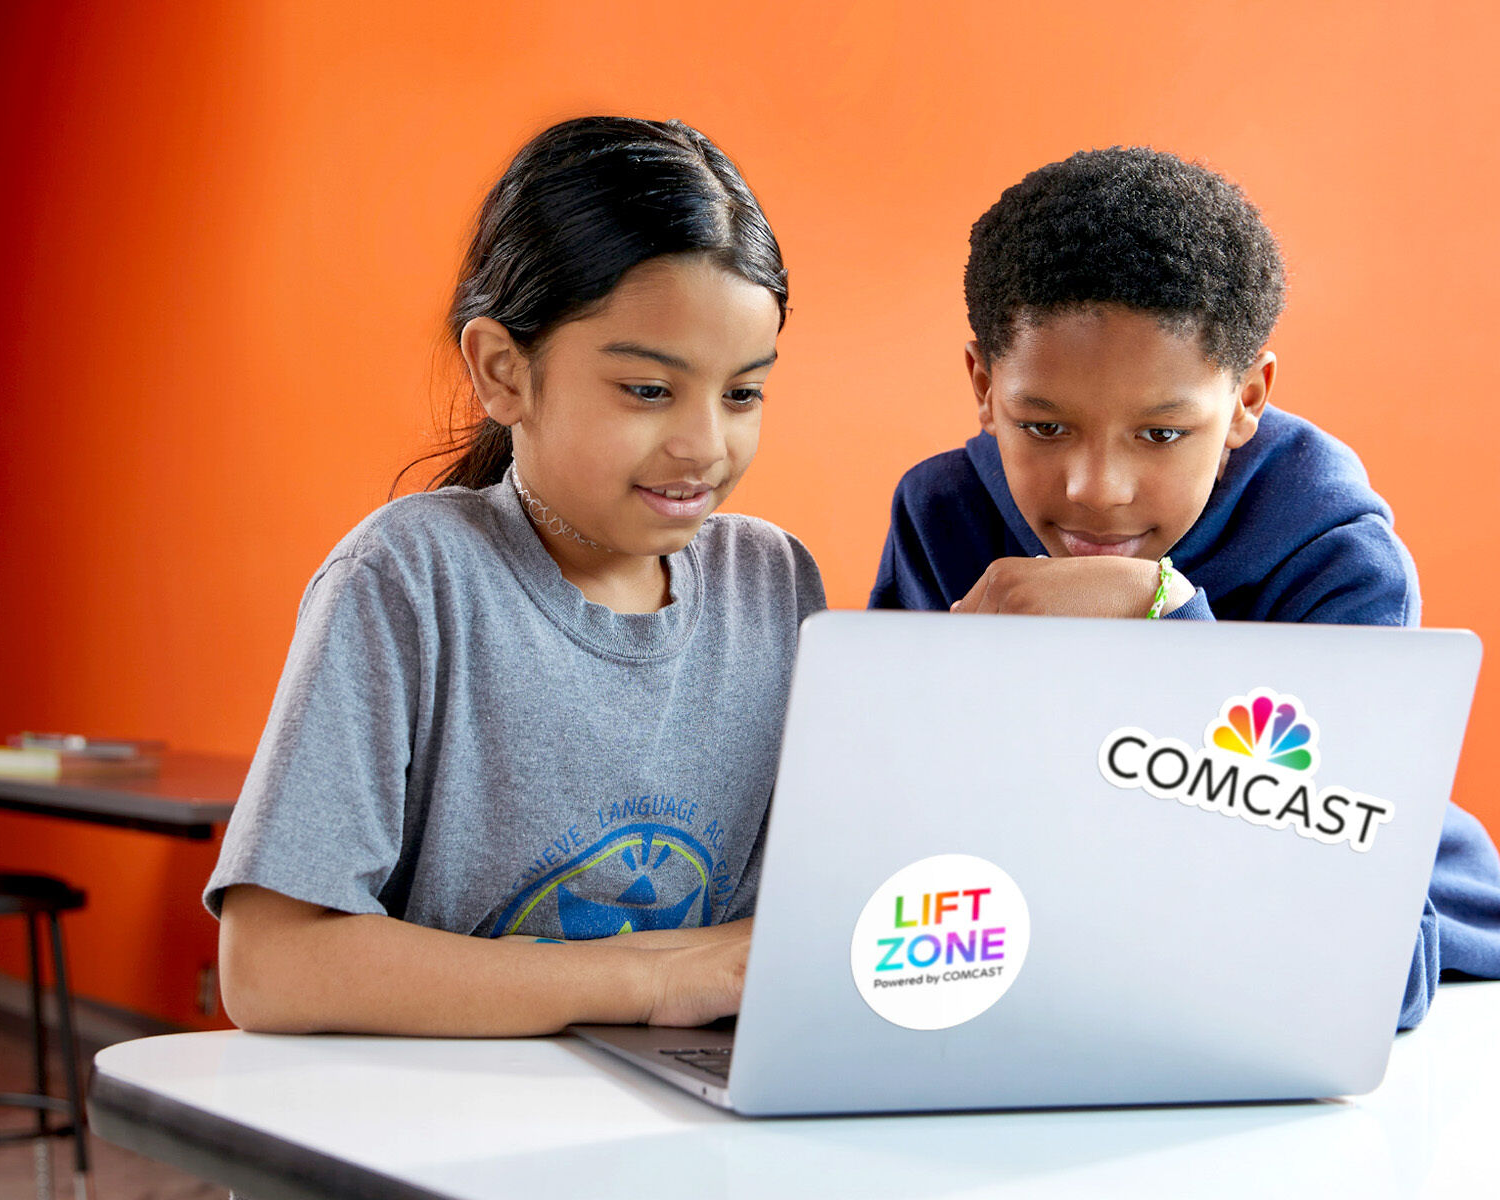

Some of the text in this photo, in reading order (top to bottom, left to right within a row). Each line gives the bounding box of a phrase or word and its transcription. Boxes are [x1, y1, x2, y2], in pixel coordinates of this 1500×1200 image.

[1107, 735, 1387, 844] COMCAST
[503, 794, 734, 907] CHIEVE LANGUAGE ACEMY
[894, 887, 991, 928] LIFT
[874, 926, 1006, 972] ZONE
[873, 966, 1004, 988] Powered by COMCAST
